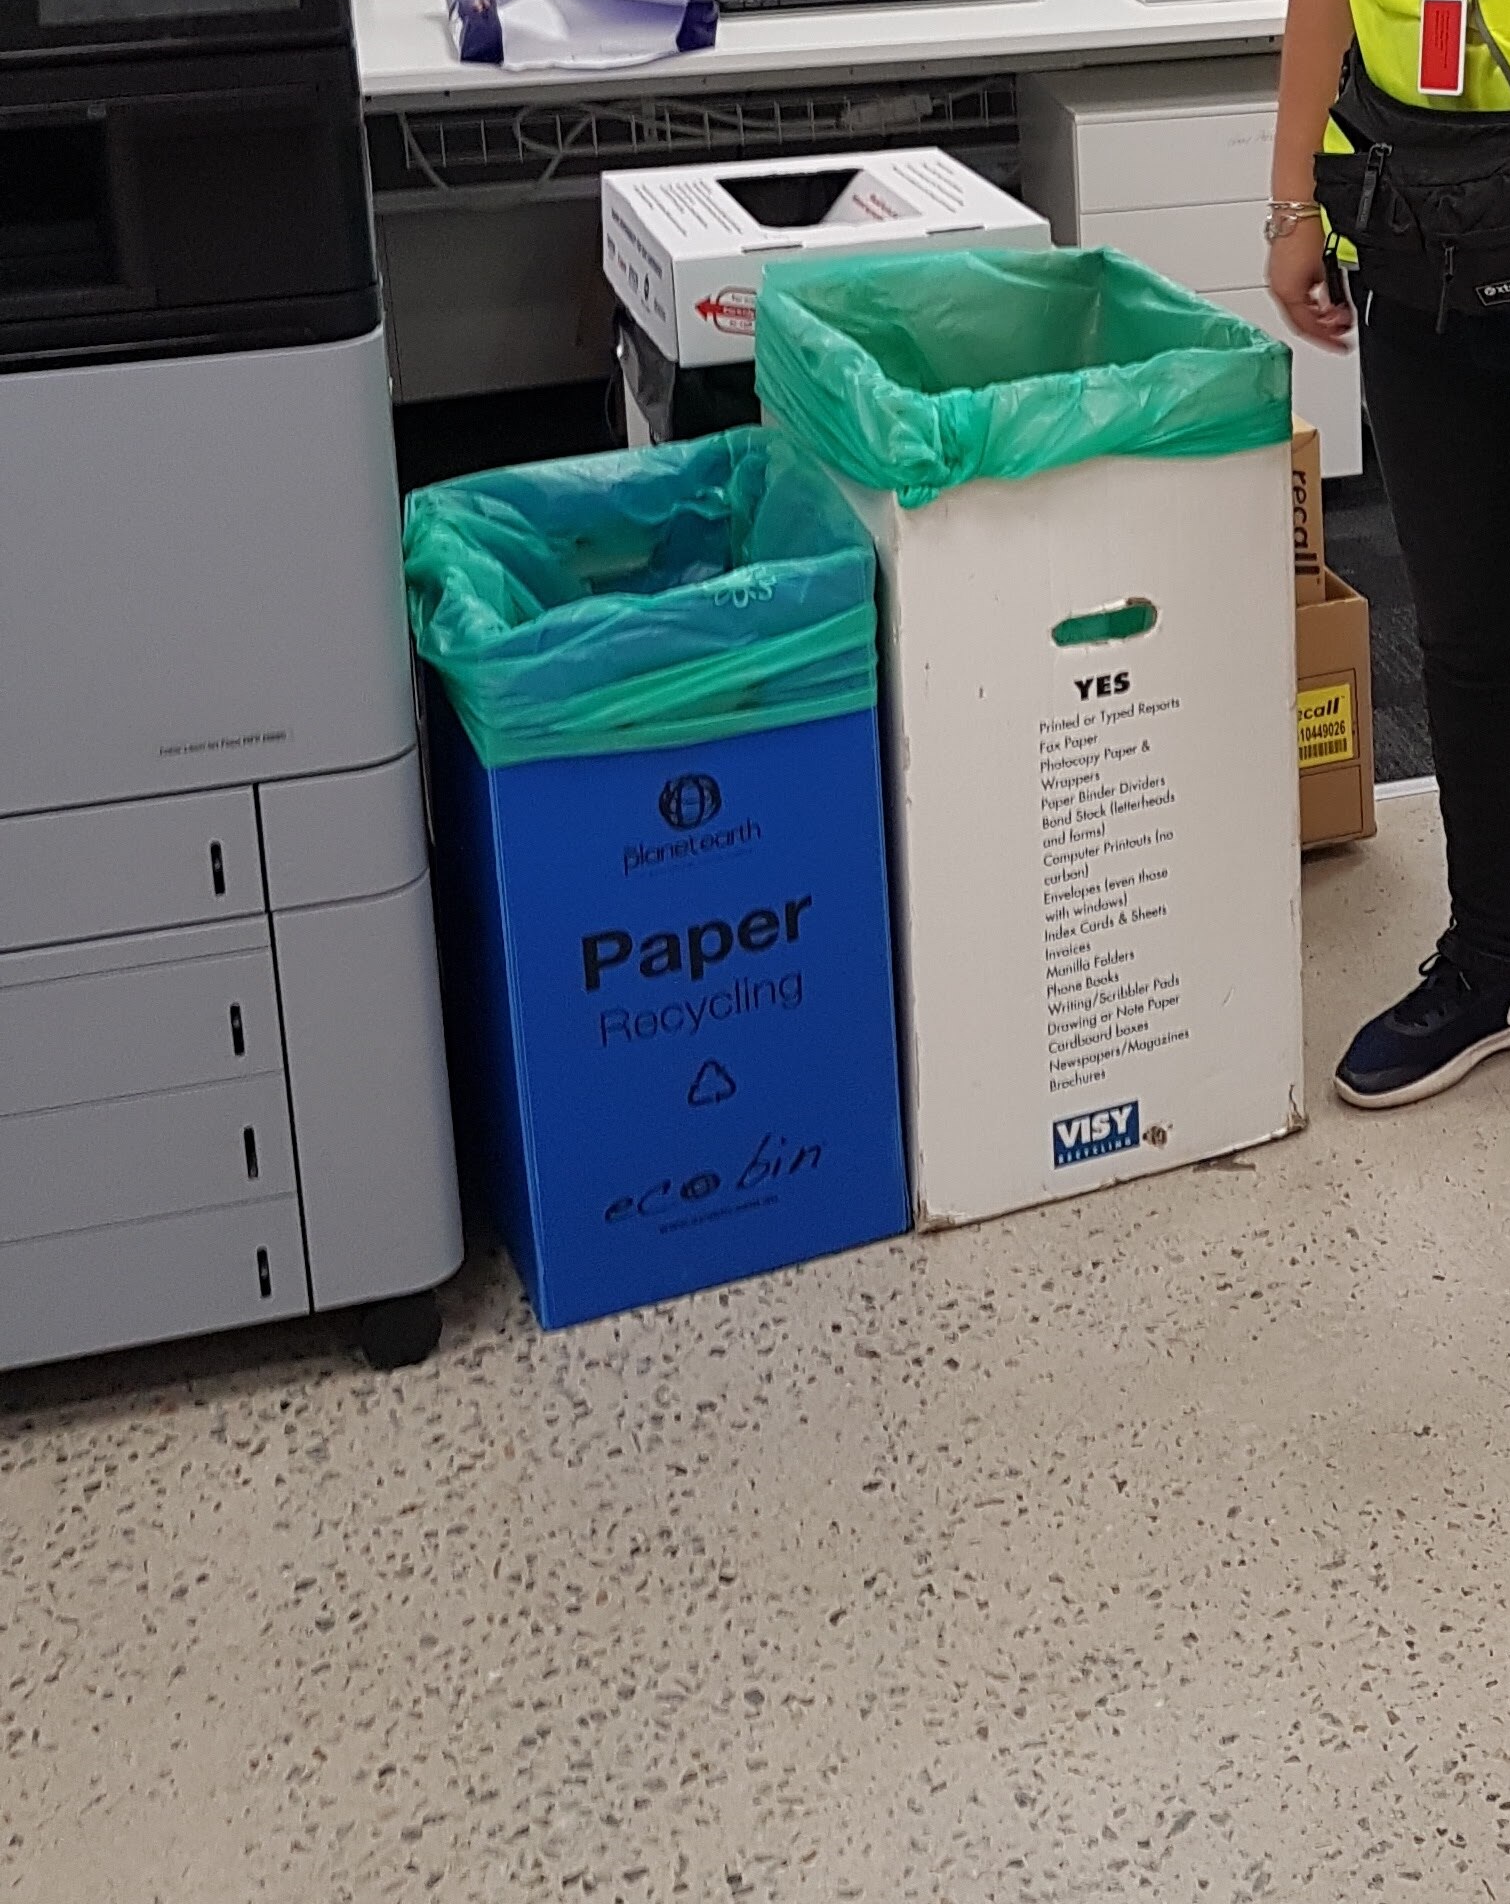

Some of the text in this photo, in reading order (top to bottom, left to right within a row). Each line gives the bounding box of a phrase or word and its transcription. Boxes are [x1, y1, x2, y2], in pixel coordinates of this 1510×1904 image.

[1074, 672, 1130, 701] YES
[1040, 698, 1180, 734] Printed or Typed Reports
[1040, 735, 1098, 754] Fax Paper
[1040, 739, 1151, 773] Photocopy Paper &
[1041, 775, 1165, 811] Paper Binder Dividers
[1042, 772, 1100, 791] Wrappers
[1042, 789, 1175, 829] Bond Stock (letterheads
[1043, 821, 1105, 849] and forms)
[1044, 828, 1174, 867] Computer Printouts (no
[1044, 863, 1089, 886] carbon)
[1044, 868, 1168, 905] Envelopes (even those
[1044, 904, 1167, 942] Index Cards & Sheets
[1045, 891, 1128, 922] with windows)
[582, 895, 812, 992] Paper
[1045, 943, 1091, 961] Invoices
[1046, 949, 1135, 979] Manilla Folders
[1047, 969, 1119, 999] Phone Books
[1048, 973, 1180, 1016] Writing/Scribbler Pads
[600, 971, 803, 1047] Recycling
[1048, 995, 1179, 1035] Drawing or Note Paper
[1048, 1021, 1149, 1054] Cardboard boxes
[1050, 1028, 1189, 1073] Newspapers/Magazines
[1050, 1069, 1105, 1092] Brochures
[1056, 1104, 1133, 1149] VISY
[736, 1132, 823, 1191] bin
